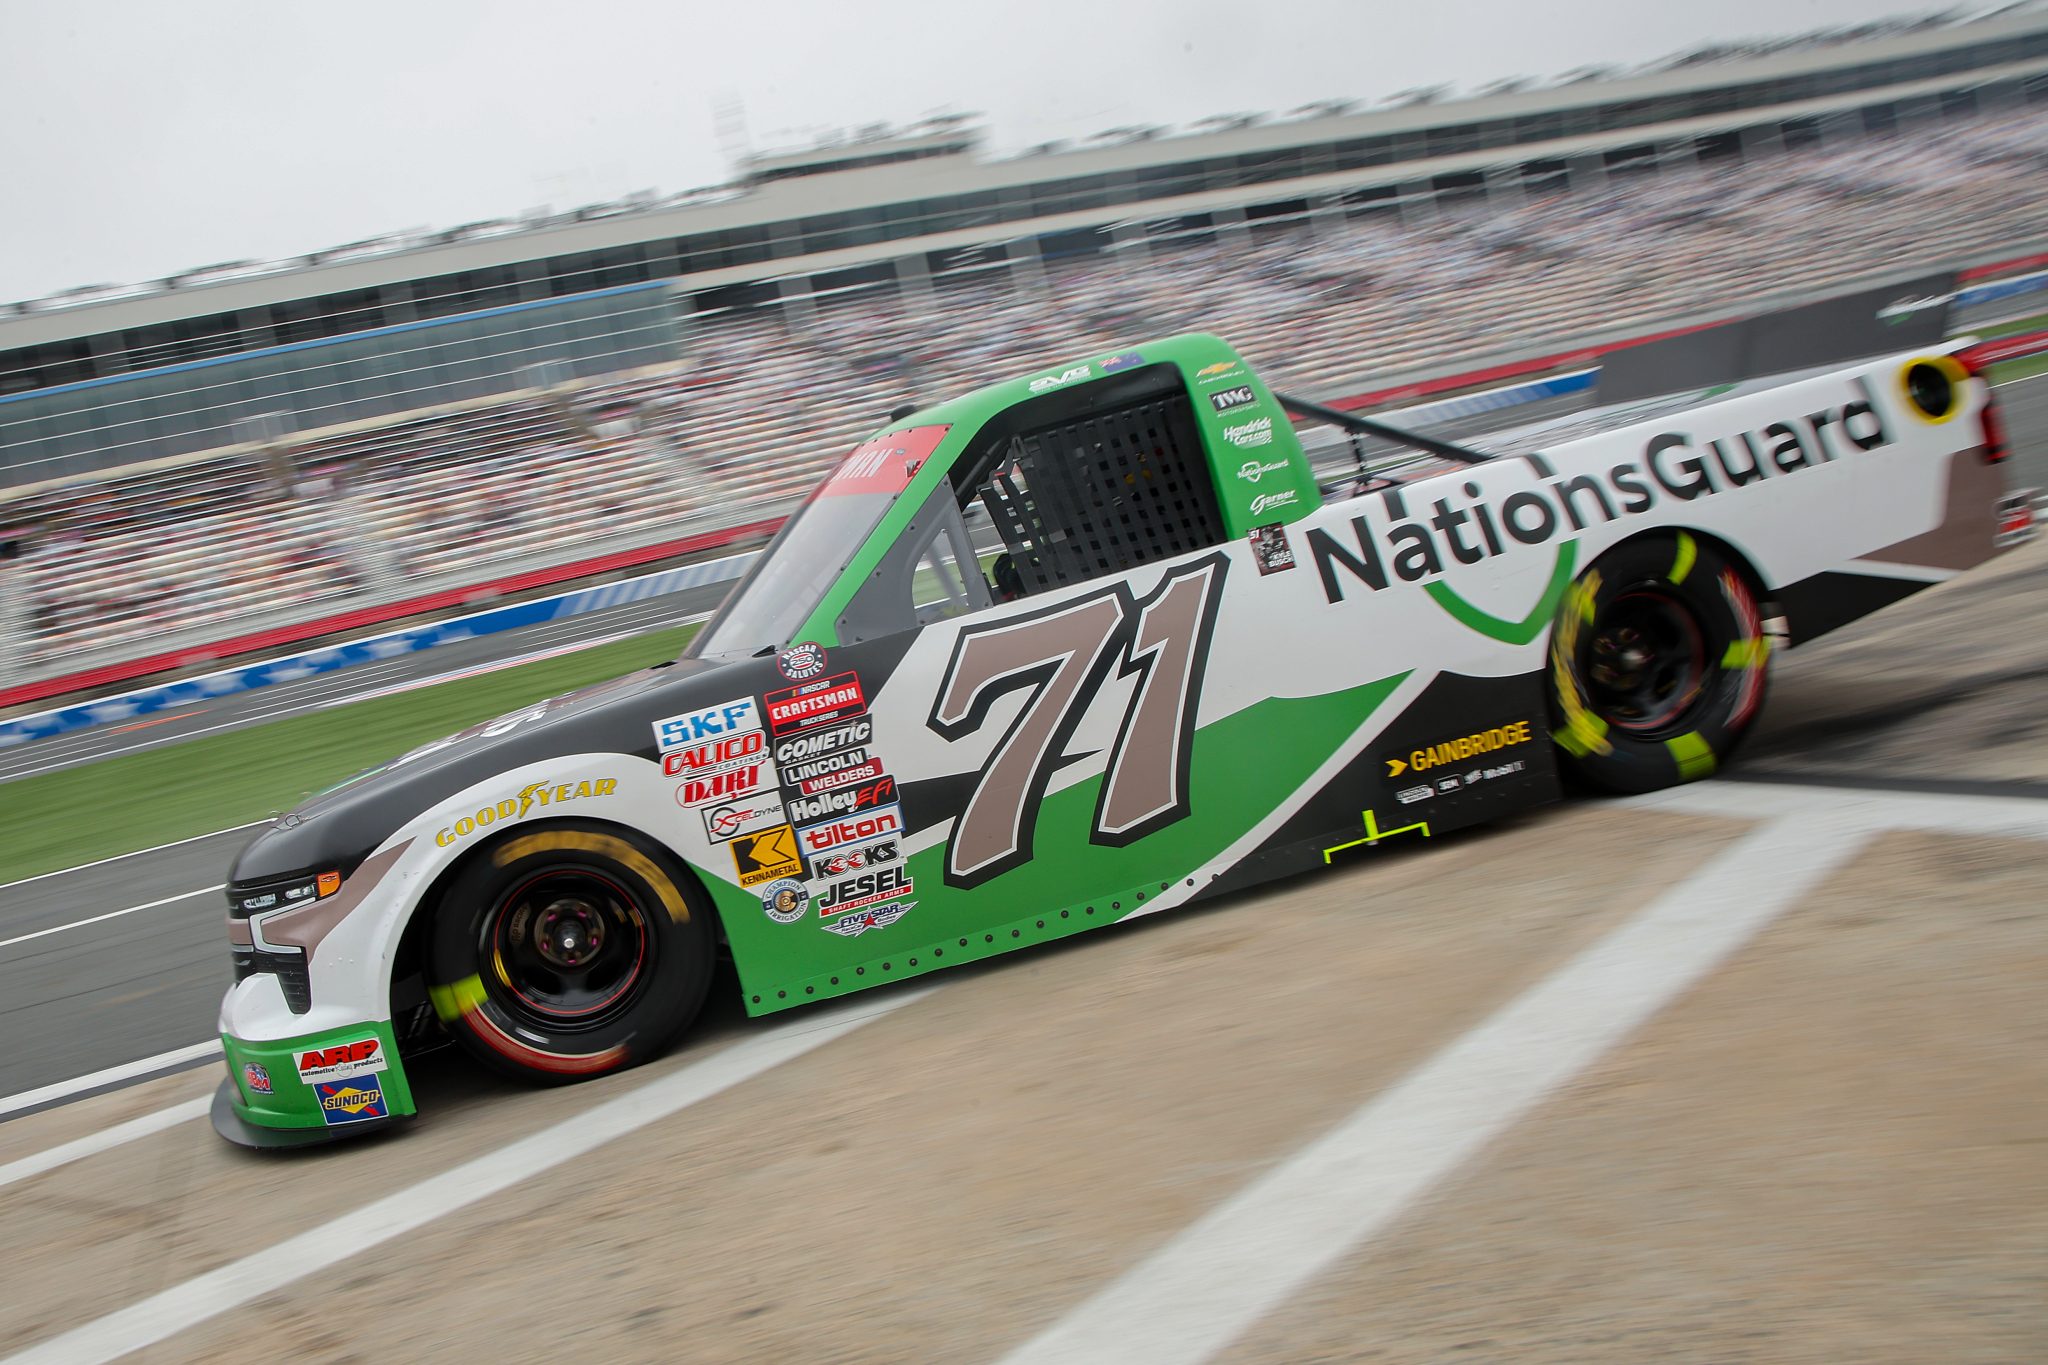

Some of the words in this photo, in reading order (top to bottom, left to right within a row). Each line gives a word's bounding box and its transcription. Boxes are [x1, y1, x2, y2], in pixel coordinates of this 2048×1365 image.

[1224, 416, 1272, 442] Hendrick
[1250, 489, 1296, 515] Garner
[1304, 375, 1894, 605] NationsGuard
[781, 644, 817, 660] NASCAR
[786, 661, 824, 679] SALUTES
[801, 680, 831, 694] NASCAR
[771, 687, 858, 720] CRAFTSMAN
[661, 701, 752, 747] SKF
[926, 550, 1231, 890] 71
[663, 732, 763, 777] CALICO
[777, 722, 871, 761] COMETIC
[1409, 720, 1533, 772] GAINBRIDGE
[787, 750, 865, 783] LINCOLN
[808, 765, 875, 791] WELDERS
[684, 765, 759, 804] DART
[435, 778, 618, 847] GOODYEAR
[789, 790, 858, 821] Holley
[805, 814, 897, 850] tilton
[741, 863, 799, 886] KENNAMETAL
[814, 840, 899, 879] KOOKS
[766, 880, 801, 899] CHAMPION
[820, 866, 912, 908] JESEL
[828, 903, 851, 913] SHAFT
[854, 895, 882, 907] ROCKER
[884, 889, 905, 898] ARMS
[769, 901, 807, 921] IRRIGATION
[840, 913, 867, 927] FIVE
[871, 904, 901, 917] STAR
[299, 1039, 379, 1071] ARP
[353, 1057, 383, 1070] products
[301, 1066, 335, 1077] automotive
[326, 1090, 378, 1109] SUNOCO
